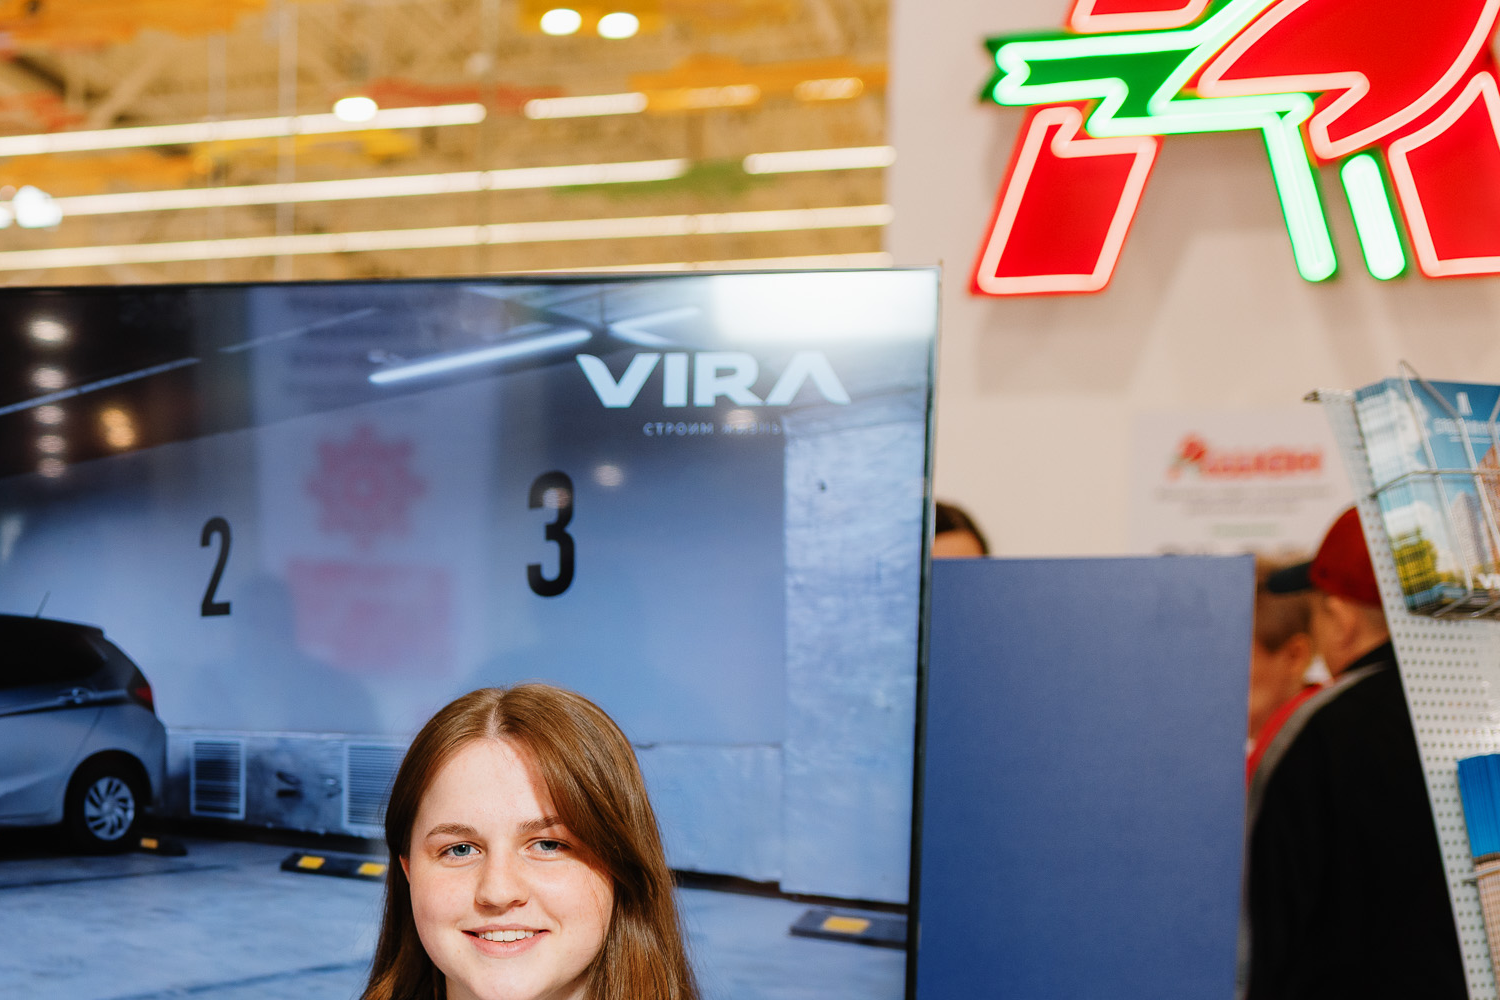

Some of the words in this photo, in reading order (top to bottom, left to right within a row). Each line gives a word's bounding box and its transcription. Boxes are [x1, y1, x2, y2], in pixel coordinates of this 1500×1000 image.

[576, 352, 851, 408] VIRA
[642, 421, 714, 436] СТРОИМ
[199, 516, 232, 617] 2
[526, 470, 576, 598] 3
